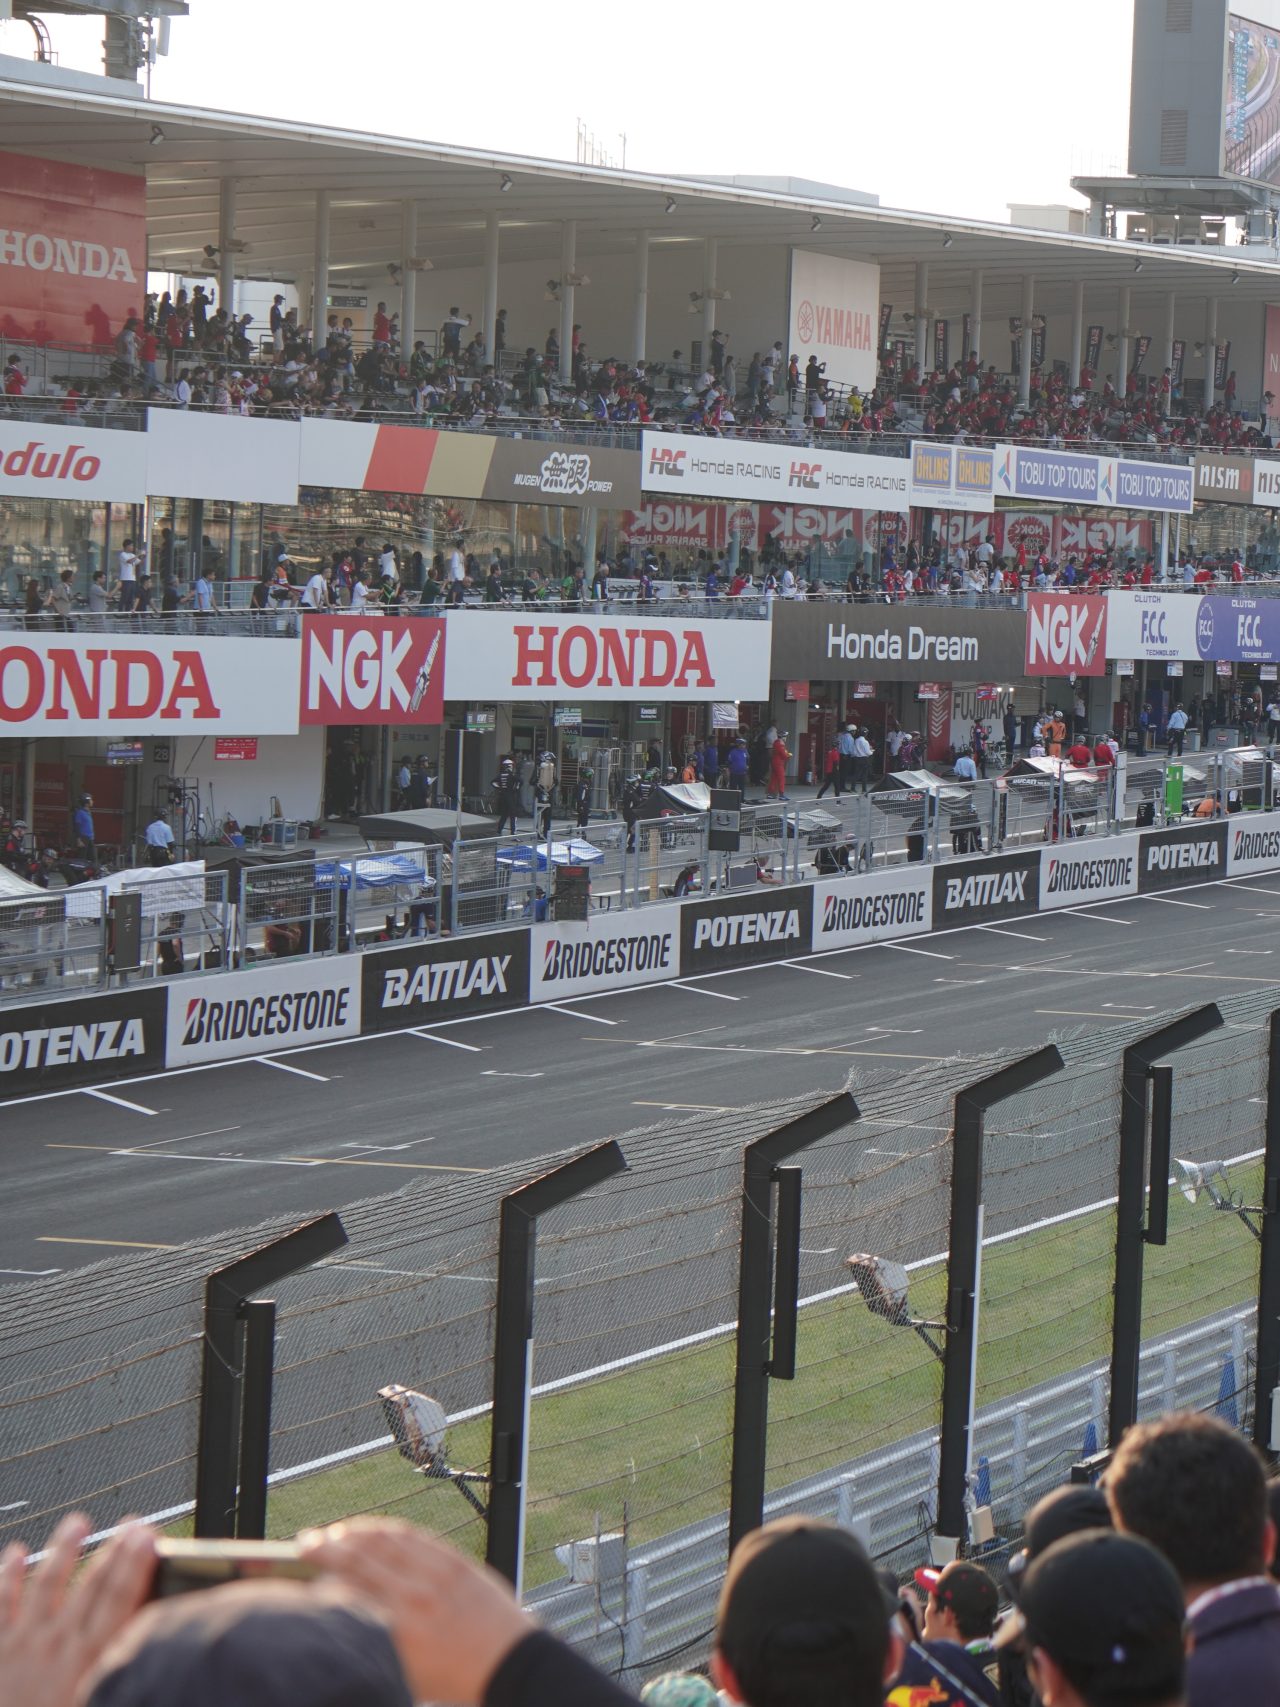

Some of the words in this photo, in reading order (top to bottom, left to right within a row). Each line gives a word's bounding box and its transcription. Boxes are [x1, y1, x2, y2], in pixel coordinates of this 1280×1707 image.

[0, 229, 137, 284] HONDA
[816, 305, 871, 351] YAMAHA
[542, 452, 590, 495] 無限
[649, 448, 687, 477] HRC
[691, 458, 735, 476] Honda
[737, 463, 781, 480] RACING
[788, 461, 822, 489] HRC
[826, 472, 864, 488] Honda
[867, 476, 907, 491] RACING
[1020, 461, 1045, 483] TOBU
[1048, 464, 1066, 487] TOP
[1068, 467, 1096, 491] TOURS
[514, 473, 541, 487] MUGEN
[587, 480, 612, 493] POWER
[1120, 473, 1144, 496] TOBU
[1146, 476, 1162, 498] TOP
[1163, 478, 1190, 501] TOURS
[1134, 594, 1161, 603] CLUTCH
[1231, 600, 1257, 609] CLUTCH
[827, 624, 902, 660] Honda
[908, 626, 978, 662] Dream
[1029, 602, 1089, 667] NGK
[1140, 610, 1168, 645] F.C.C.
[1237, 615, 1262, 647] F.C.C.
[308, 628, 413, 712] NGK
[511, 625, 715, 690] HONDA
[1146, 649, 1179, 657] TECHNOLOGY
[1241, 651, 1272, 659] TECHNOLOGY
[155, 749, 169, 761] 28
[1147, 841, 1219, 871] POTENZA
[945, 871, 1028, 910] BATTLAX
[1047, 857, 1133, 893] BRIDGESTONE
[694, 909, 800, 949] POTENZA
[822, 890, 925, 932] BRIDGESTONE
[542, 933, 672, 981] BRIDGESTONE
[382, 954, 512, 1008] BATTLAX
[181, 987, 350, 1046] BRIDGESTONE
